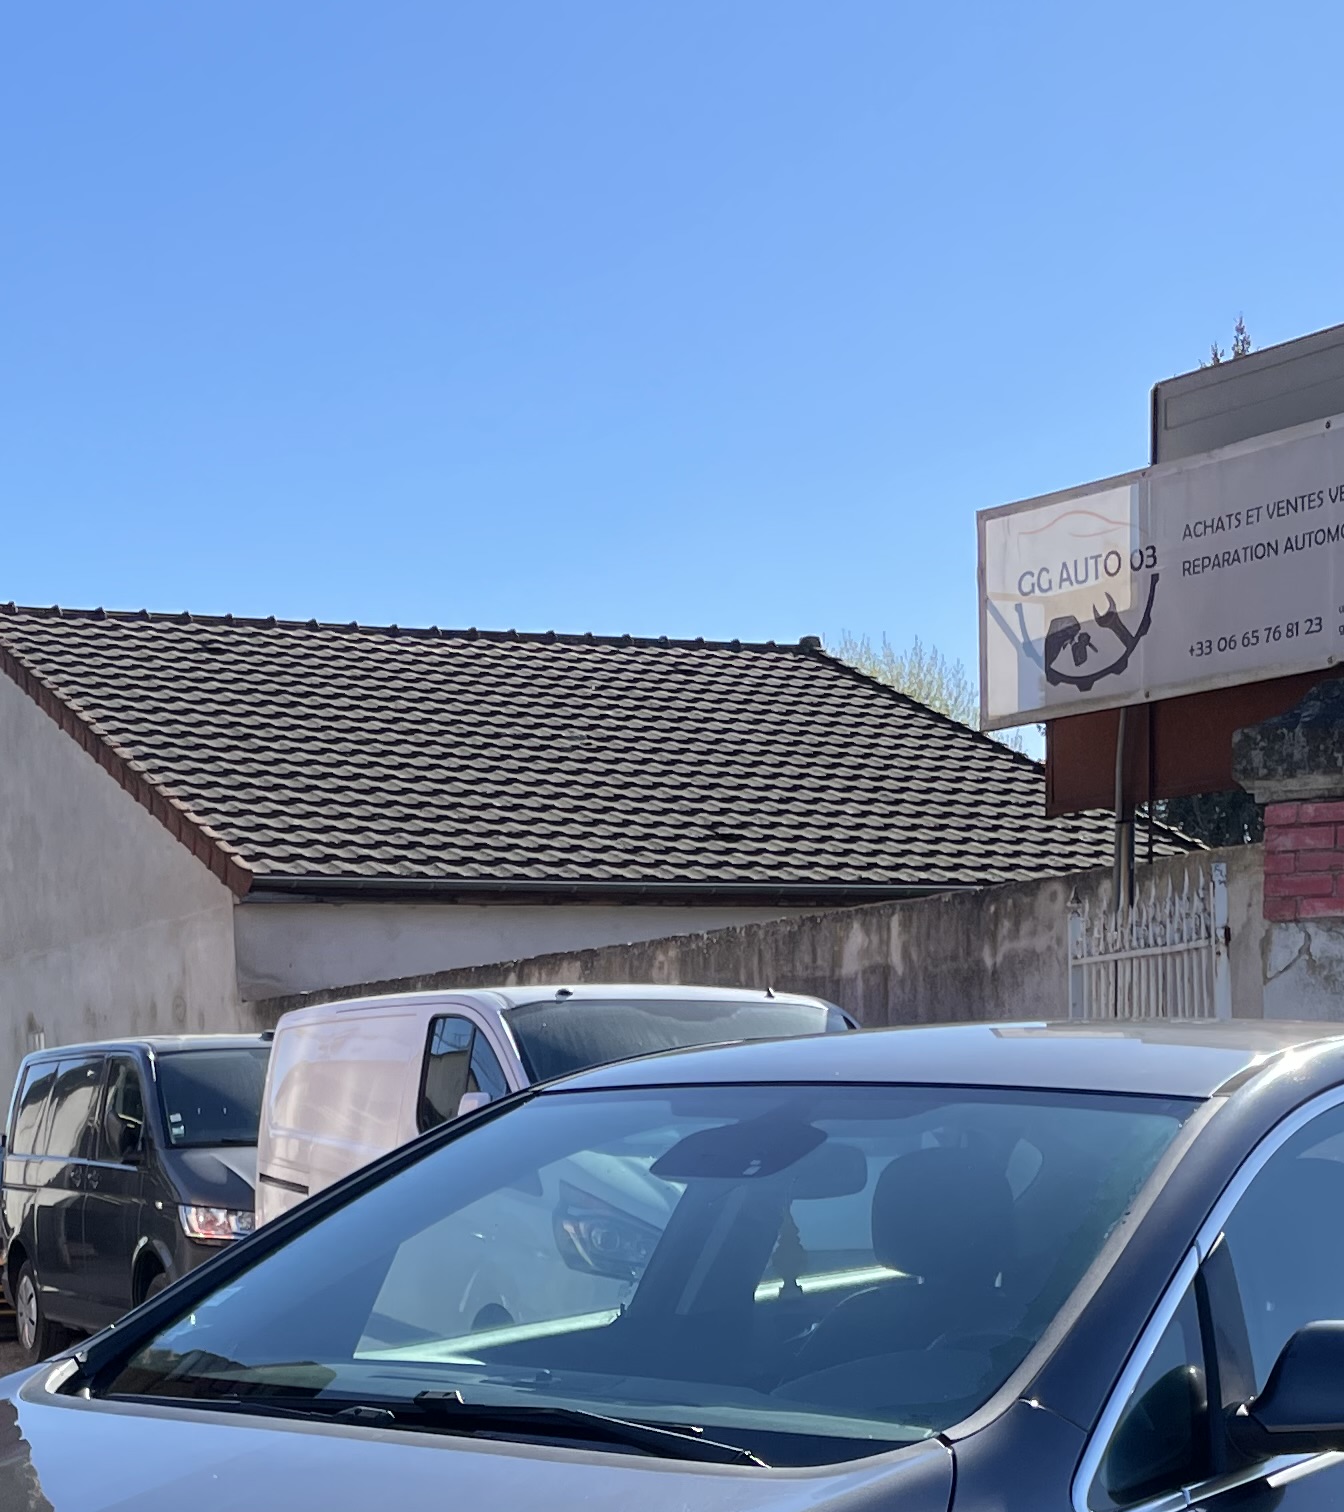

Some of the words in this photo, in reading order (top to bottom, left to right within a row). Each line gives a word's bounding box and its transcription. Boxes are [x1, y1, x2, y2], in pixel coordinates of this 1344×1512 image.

[1182, 511, 1242, 542] ACHATS
[1246, 505, 1263, 526] ET
[1266, 490, 1324, 520] VENTES
[1017, 566, 1053, 597] GG
[1058, 549, 1122, 590] AUTO
[1129, 544, 1158, 572] 03
[1182, 539, 1279, 577] REPARATION
[1189, 640, 1213, 657] +33
[1217, 634, 1237, 652] 06
[1241, 629, 1260, 648] 65
[1264, 624, 1282, 643] 76
[1285, 621, 1300, 638] 81
[1305, 616, 1323, 635] 23
